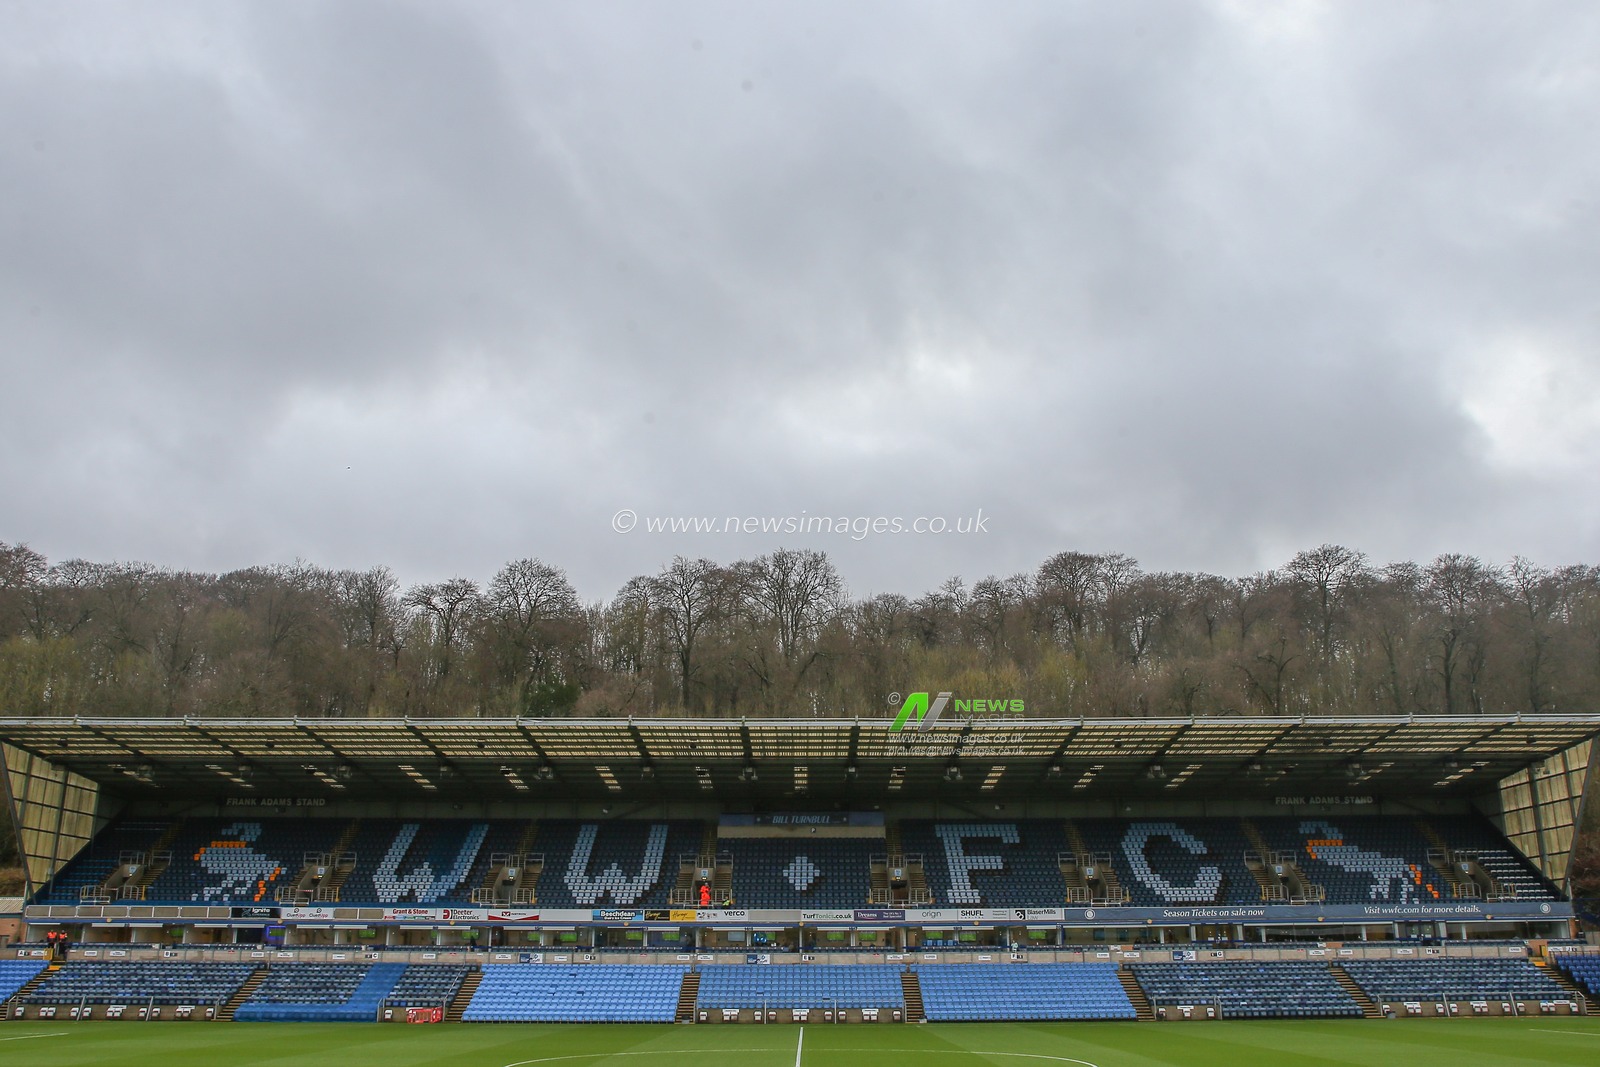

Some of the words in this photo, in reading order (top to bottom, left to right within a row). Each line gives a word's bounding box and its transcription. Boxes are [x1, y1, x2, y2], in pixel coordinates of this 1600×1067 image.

[226, 798, 257, 806] FRANK
[260, 798, 292, 806] ADAMS
[296, 798, 326, 806] STAND
[1275, 796, 1306, 805] FRANK
[1309, 796, 1339, 804] ADAMS
[1343, 796, 1373, 804] STAND
[772, 815, 788, 824] BILL
[791, 815, 831, 824] TURNBULL
[372, 824, 489, 903] W
[563, 824, 669, 904] W
[935, 824, 1020, 904] F
[1121, 822, 1223, 901] C
[1163, 909, 1190, 917] Season
[1192, 909, 1217, 917] Tickets
[1231, 908, 1247, 916] sale
[1364, 906, 1380, 914] Visit
[1455, 905, 1481, 913] details.
